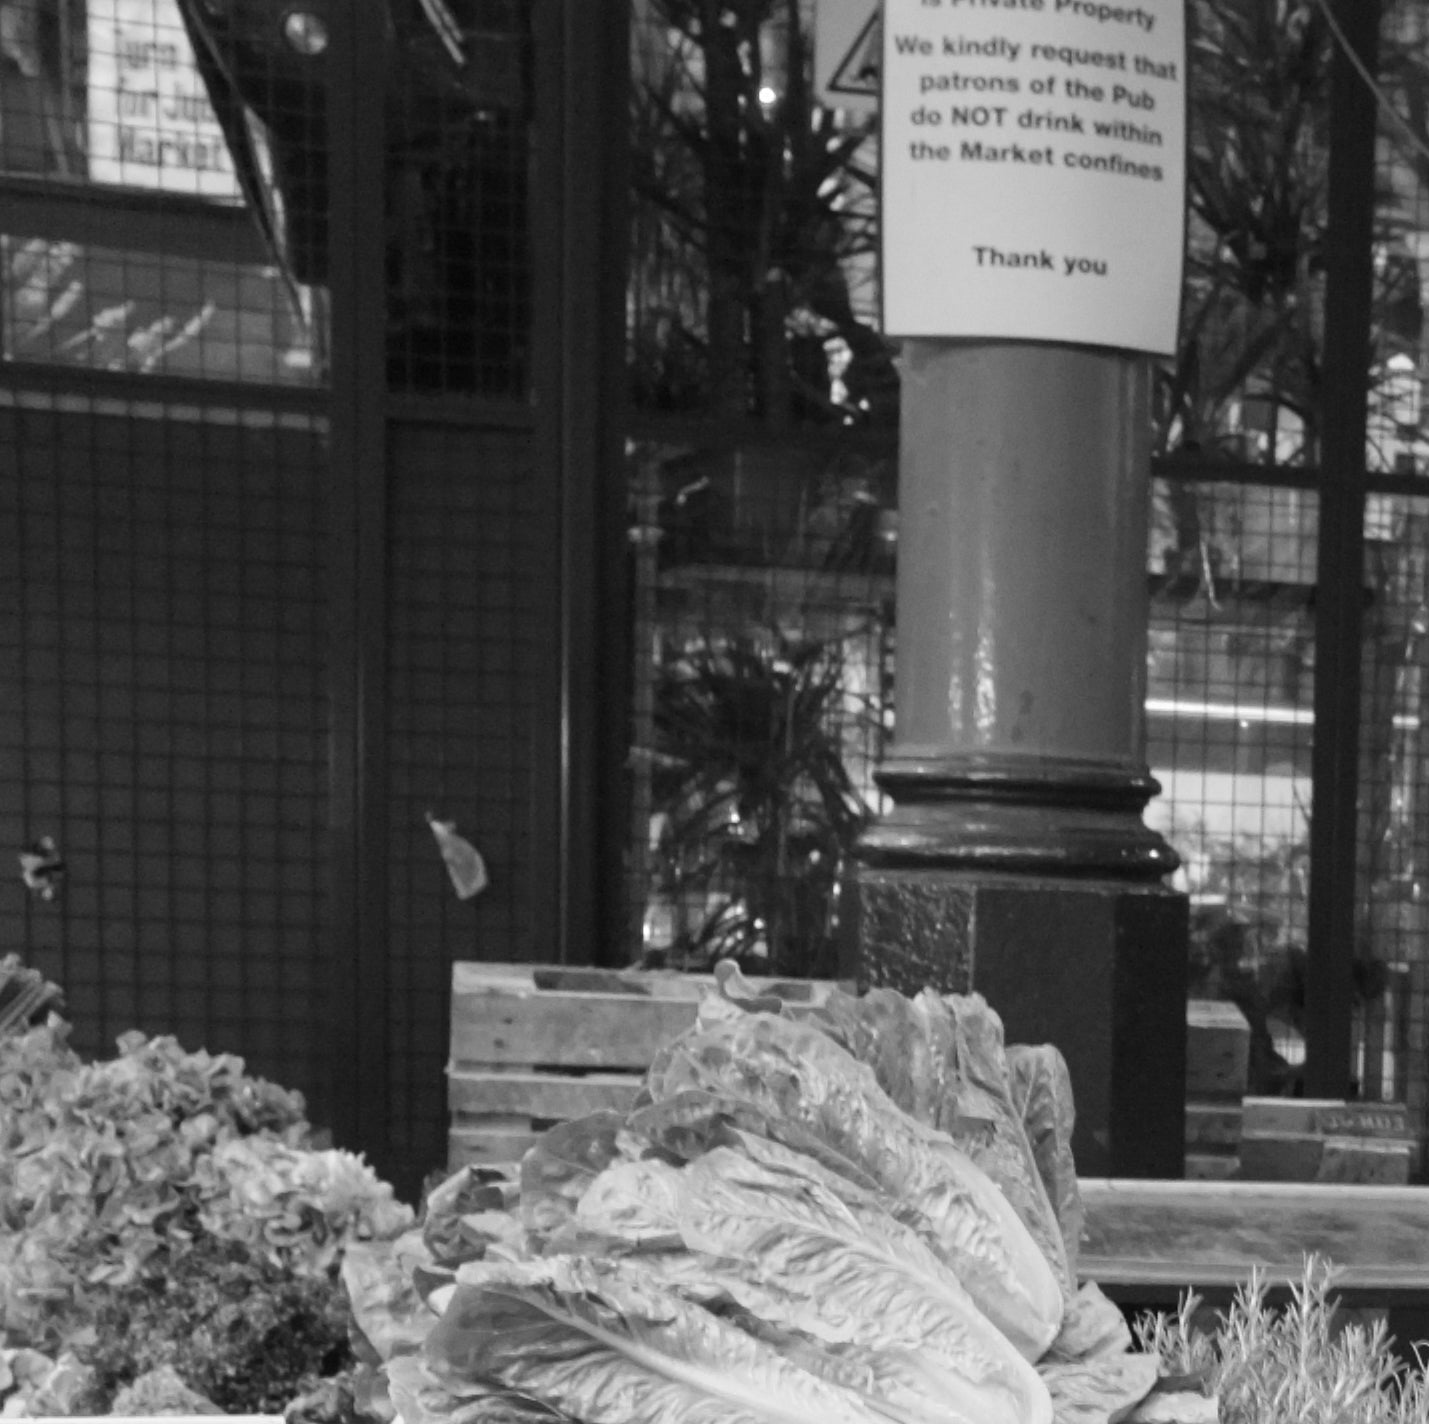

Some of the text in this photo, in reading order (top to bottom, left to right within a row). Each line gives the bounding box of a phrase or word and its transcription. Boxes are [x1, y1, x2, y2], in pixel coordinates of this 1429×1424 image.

[895, 35, 1178, 81] We kindly request that
[919, 73, 1156, 111] patrons of the Pub
[910, 107, 1164, 148] do NOT drink within
[909, 141, 1164, 182] the Market confines
[973, 246, 1110, 277] Thank you
